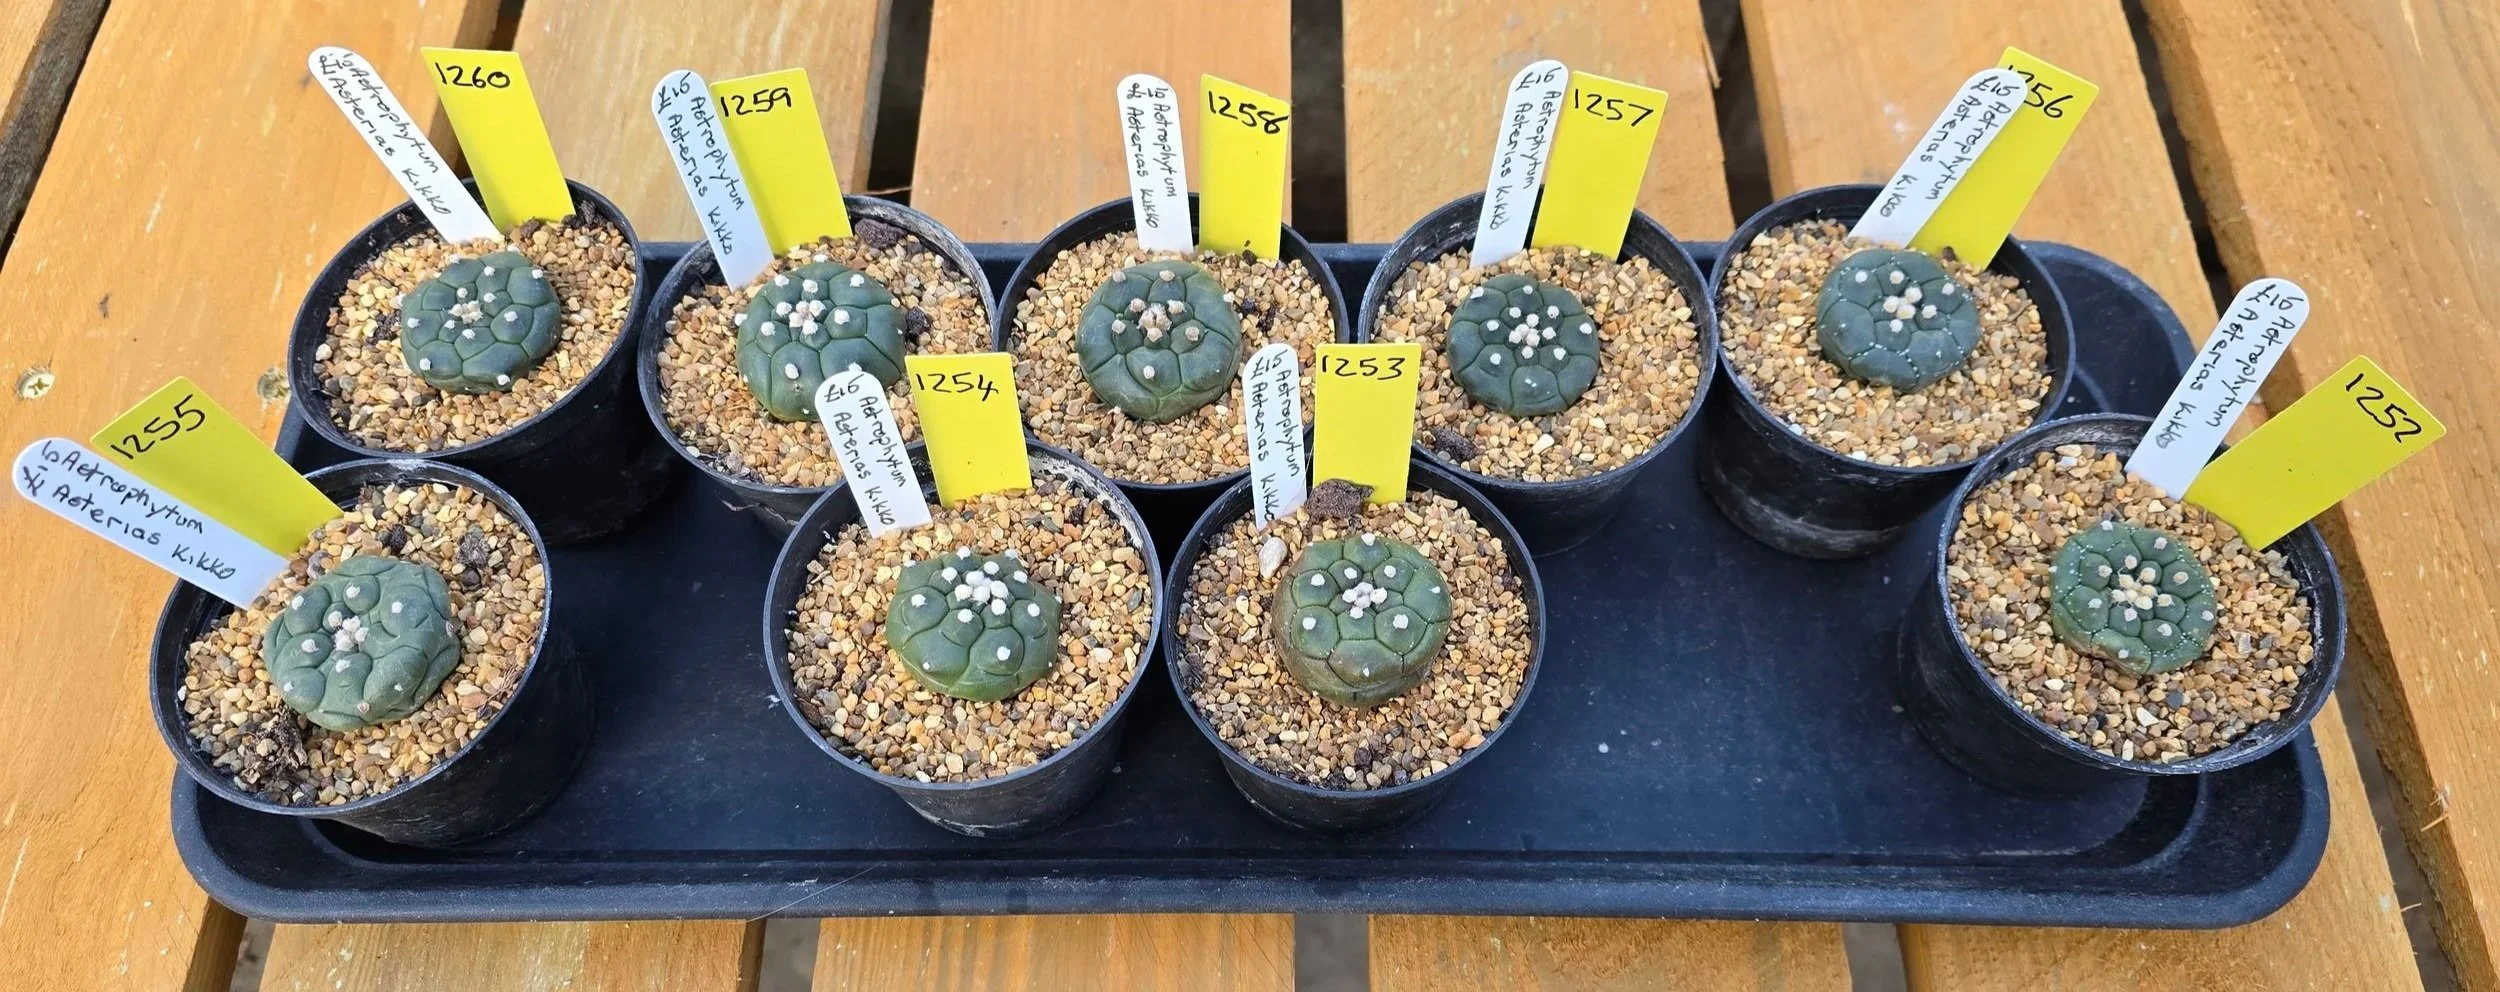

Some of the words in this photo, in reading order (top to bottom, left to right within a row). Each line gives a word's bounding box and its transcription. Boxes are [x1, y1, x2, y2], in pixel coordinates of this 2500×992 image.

[435, 62, 510, 88] 1260
[721, 88, 792, 117] 1259
[1209, 91, 1289, 134] 1258
[1575, 89, 1654, 127] 1257
[328, 77, 395, 156] Asterias
[349, 67, 439, 173] Astrophytum
[691, 96, 744, 210] Astrophytum
[1127, 106, 1149, 177] Asterias
[1153, 103, 1177, 197] Astrophytum
[1500, 102, 1533, 178] Asterias
[1520, 91, 1562, 189] Astrophytum
[1921, 95, 1981, 162] Asterias
[1926, 101, 2011, 200] Astrophytum
[668, 114, 708, 197] Asterias
[916, 372, 999, 402] 1254
[1322, 355, 1406, 380] 1253
[2190, 308, 2258, 391] Asterias
[2206, 316, 2295, 428] Astrophytum
[110, 394, 206, 460] 1255
[834, 412, 872, 480] Asterias
[859, 396, 907, 487] Astrophytum
[1252, 382, 1269, 462] Asterias
[1276, 370, 1302, 476] Astrophytum
[2345, 373, 2422, 443] 1252
[53, 484, 161, 545] Asterias
[61, 451, 203, 534] Astrophytum
